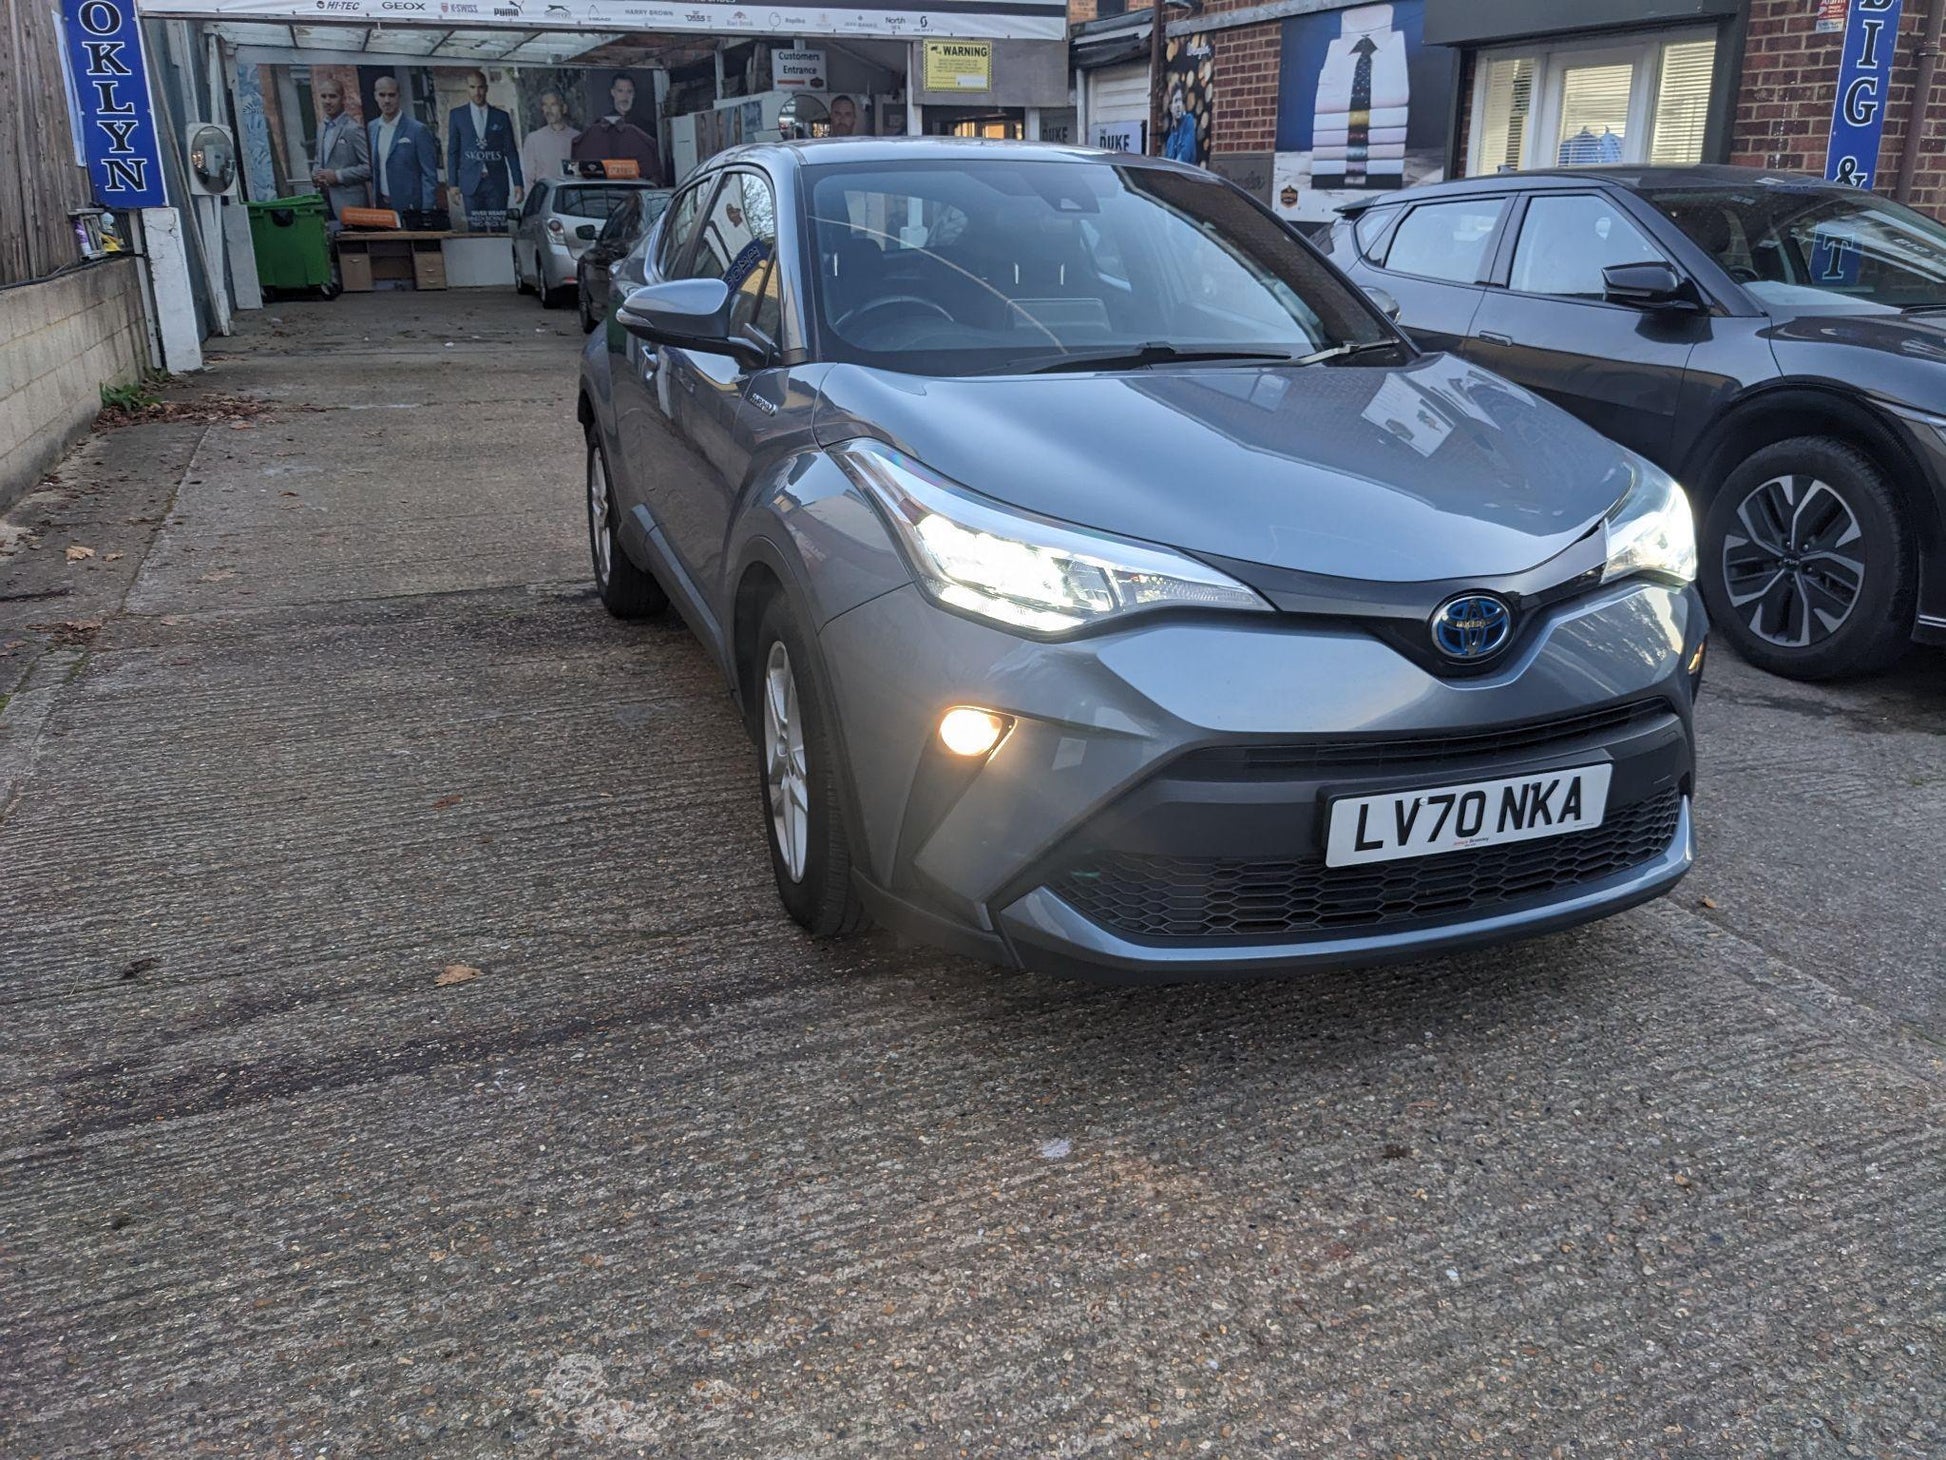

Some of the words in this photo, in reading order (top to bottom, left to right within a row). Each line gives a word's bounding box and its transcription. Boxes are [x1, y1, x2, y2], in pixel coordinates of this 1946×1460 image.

[327, 1, 360, 11] HI-TEC
[381, 1, 425, 11] GEOX
[885, 16, 906, 24] North
[778, 51, 820, 61] Customers
[943, 45, 987, 57] WARNING
[783, 65, 817, 75] Entrance
[464, 151, 502, 161] SKOPES
[1353, 790, 1487, 852] LV70
[1496, 776, 1582, 833] NKA
